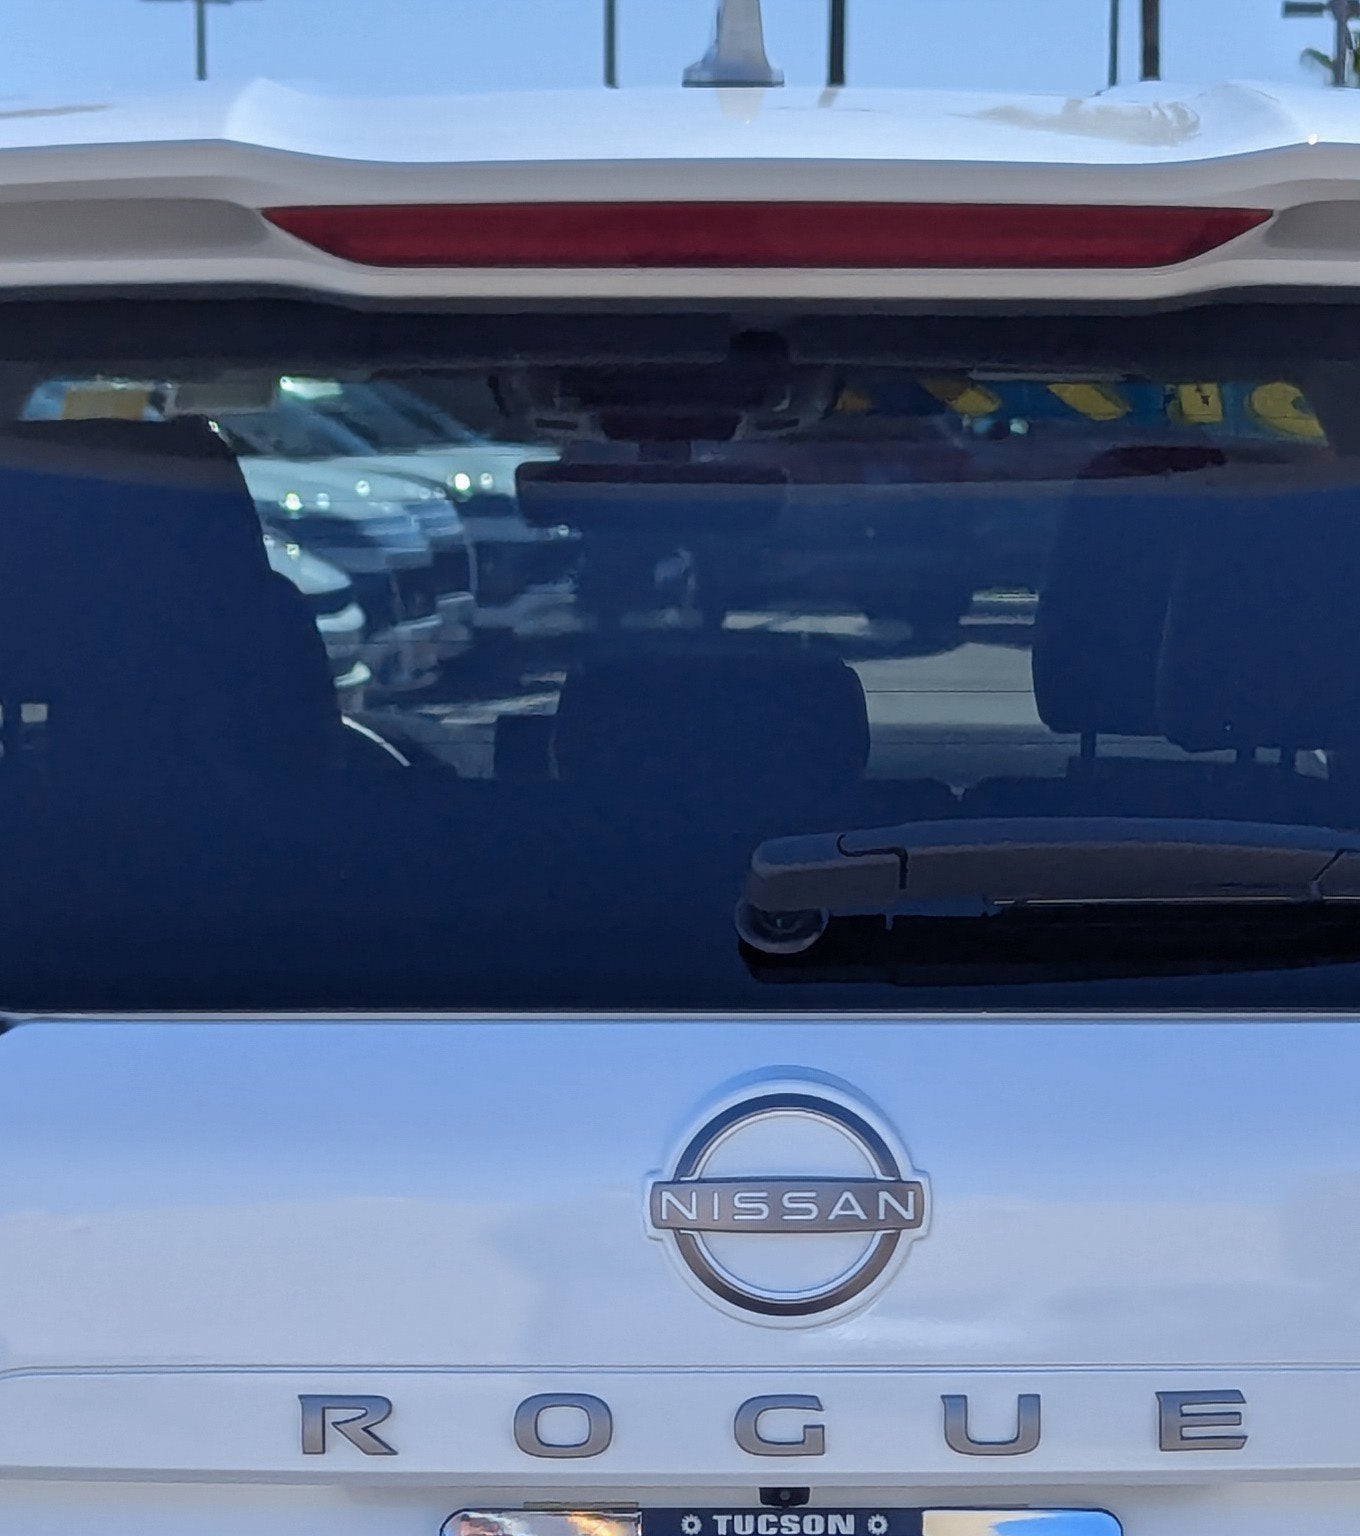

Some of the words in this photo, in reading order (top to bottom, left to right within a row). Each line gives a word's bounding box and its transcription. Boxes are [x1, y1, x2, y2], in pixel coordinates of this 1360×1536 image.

[660, 1190, 915, 1220] NISSAN
[298, 1389, 1250, 1457] ROGUE
[712, 1514, 855, 1535] TUCSON
